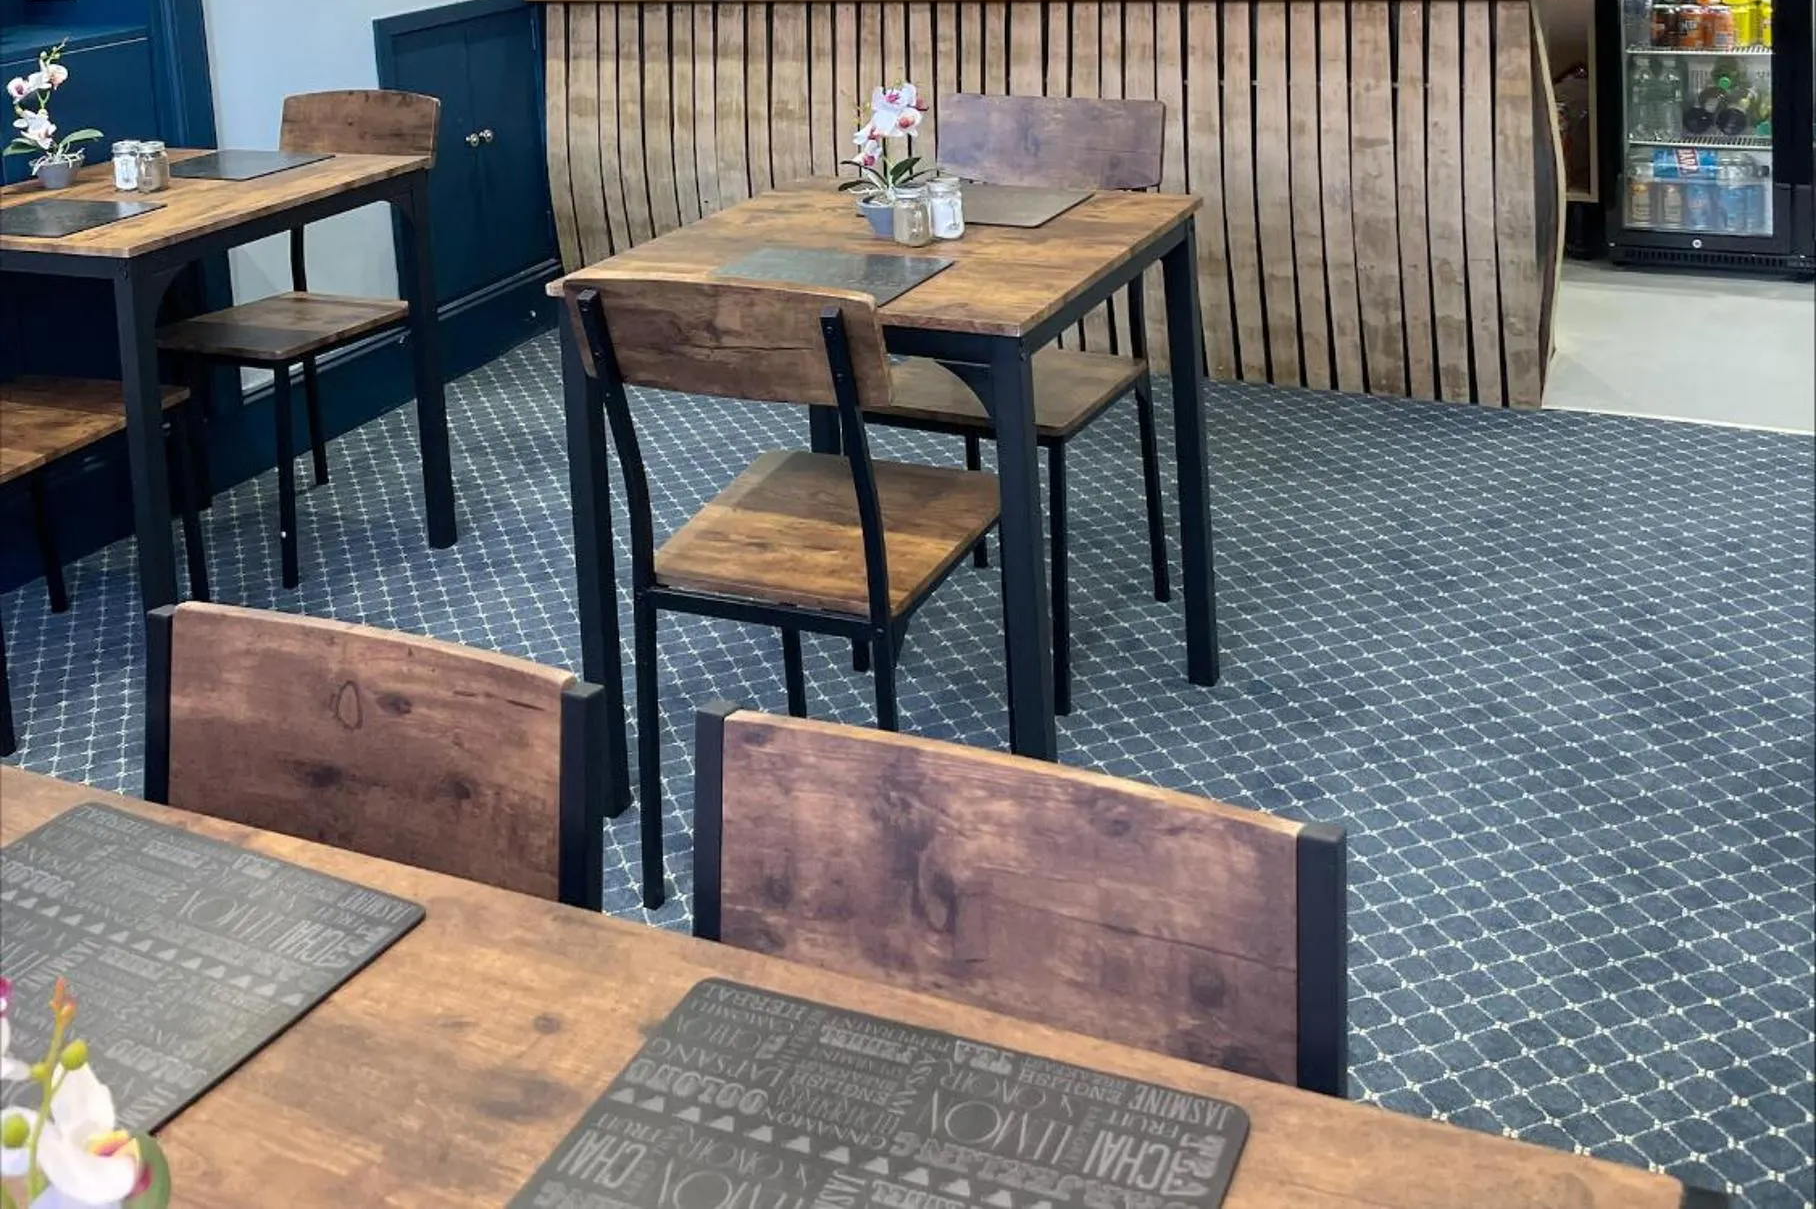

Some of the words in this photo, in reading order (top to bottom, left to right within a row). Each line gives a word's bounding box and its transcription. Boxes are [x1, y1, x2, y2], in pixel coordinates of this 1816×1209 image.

[694, 981, 809, 1020] HERBAL
[643, 1036, 785, 1087] LAPSANG
[788, 1069, 891, 1106] ENGLISH
[1017, 1068, 1124, 1104] ENGLISH
[592, 1111, 663, 1143] FRUIT
[757, 1105, 888, 1150] CINNAMON
[1105, 1108, 1180, 1140] FRUIT
[1126, 1083, 1235, 1132] JASMINE
[553, 1128, 650, 1190] CHAI
[1081, 1128, 1172, 1192] CHAI
